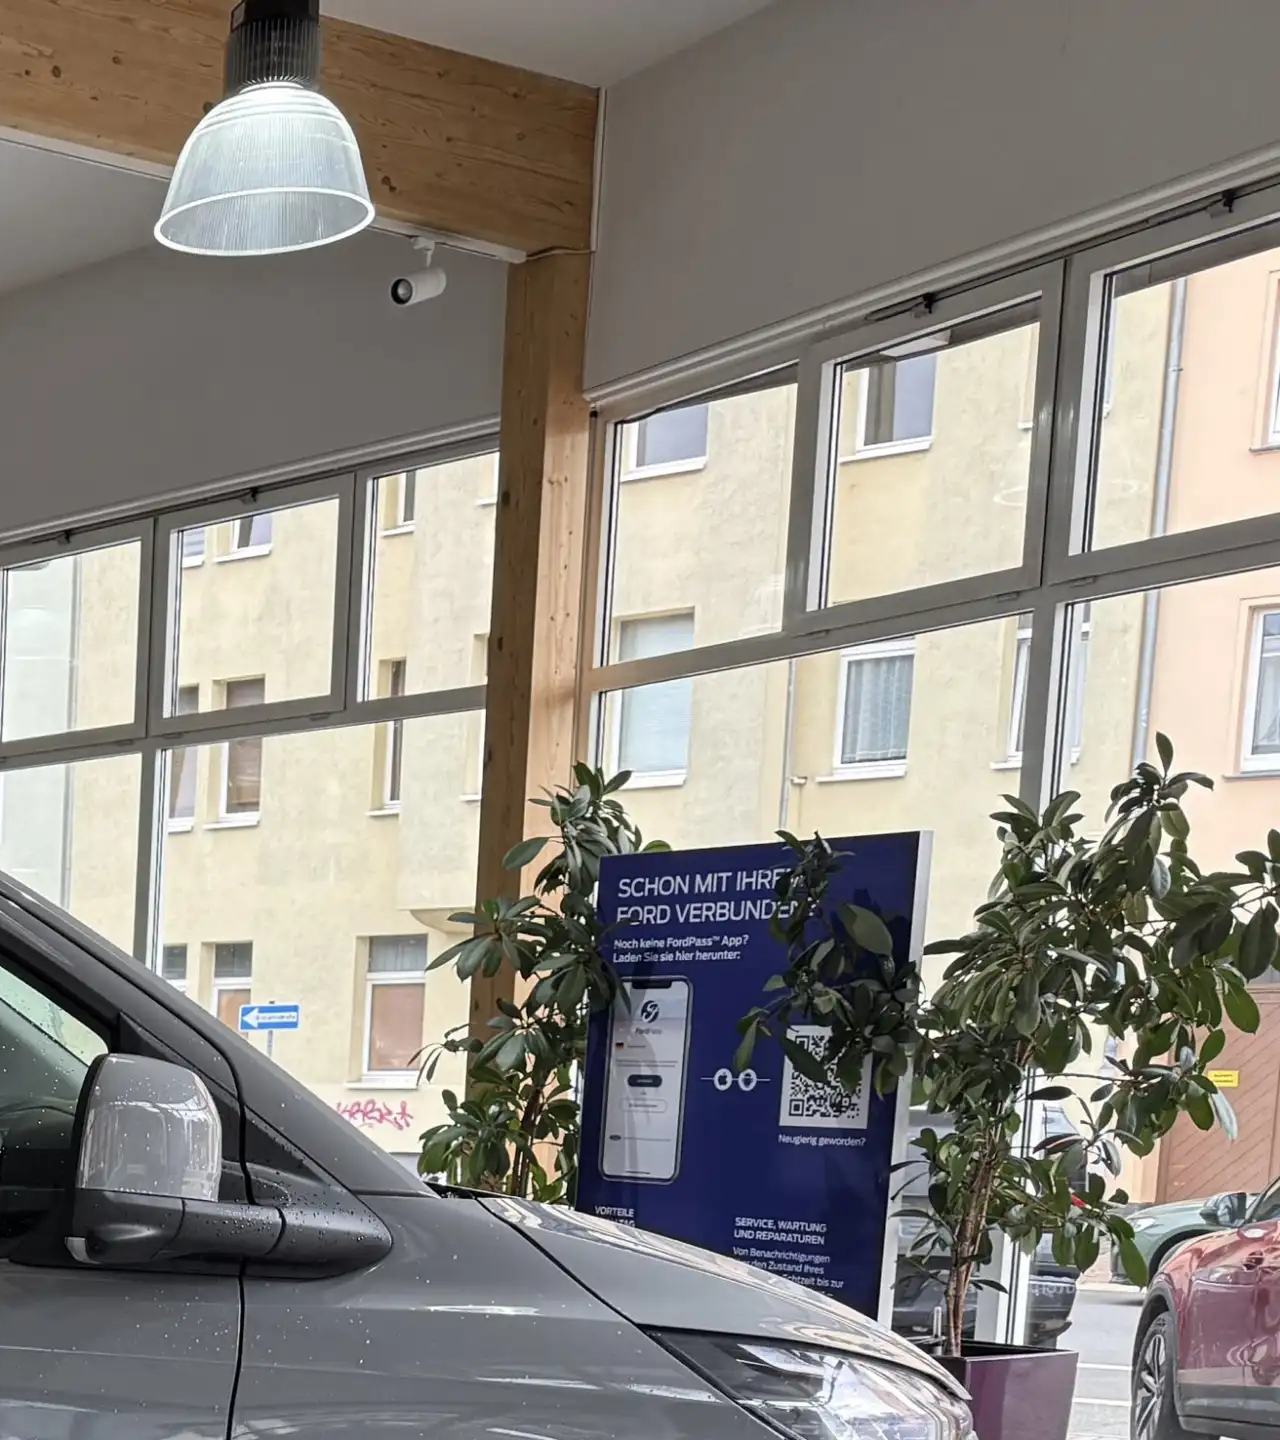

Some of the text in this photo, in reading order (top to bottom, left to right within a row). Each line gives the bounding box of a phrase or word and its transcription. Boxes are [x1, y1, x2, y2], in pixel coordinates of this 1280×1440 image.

[617, 874, 690, 898] SCHON
[694, 871, 733, 894] MIT
[616, 902, 672, 926] FORD
[613, 938, 639, 950] Noch
[640, 937, 666, 949] keine
[721, 934, 750, 949] App?
[613, 950, 741, 963] Laden Sie sie hier herunter:
[778, 1133, 867, 1148] Neugierig geworden?
[594, 1205, 635, 1218] VORTEILE
[734, 1216, 828, 1233] SERVICE, WARTUNG
[733, 1229, 826, 1245] UND REPARATUREN
[732, 1246, 749, 1256] Von
[749, 1247, 831, 1264] Benachrichtigungen
[767, 1260, 803, 1273] Zustand
[803, 1263, 825, 1275] Ihres
[816, 1277, 830, 1288] bis
[830, 1279, 845, 1290] zur
